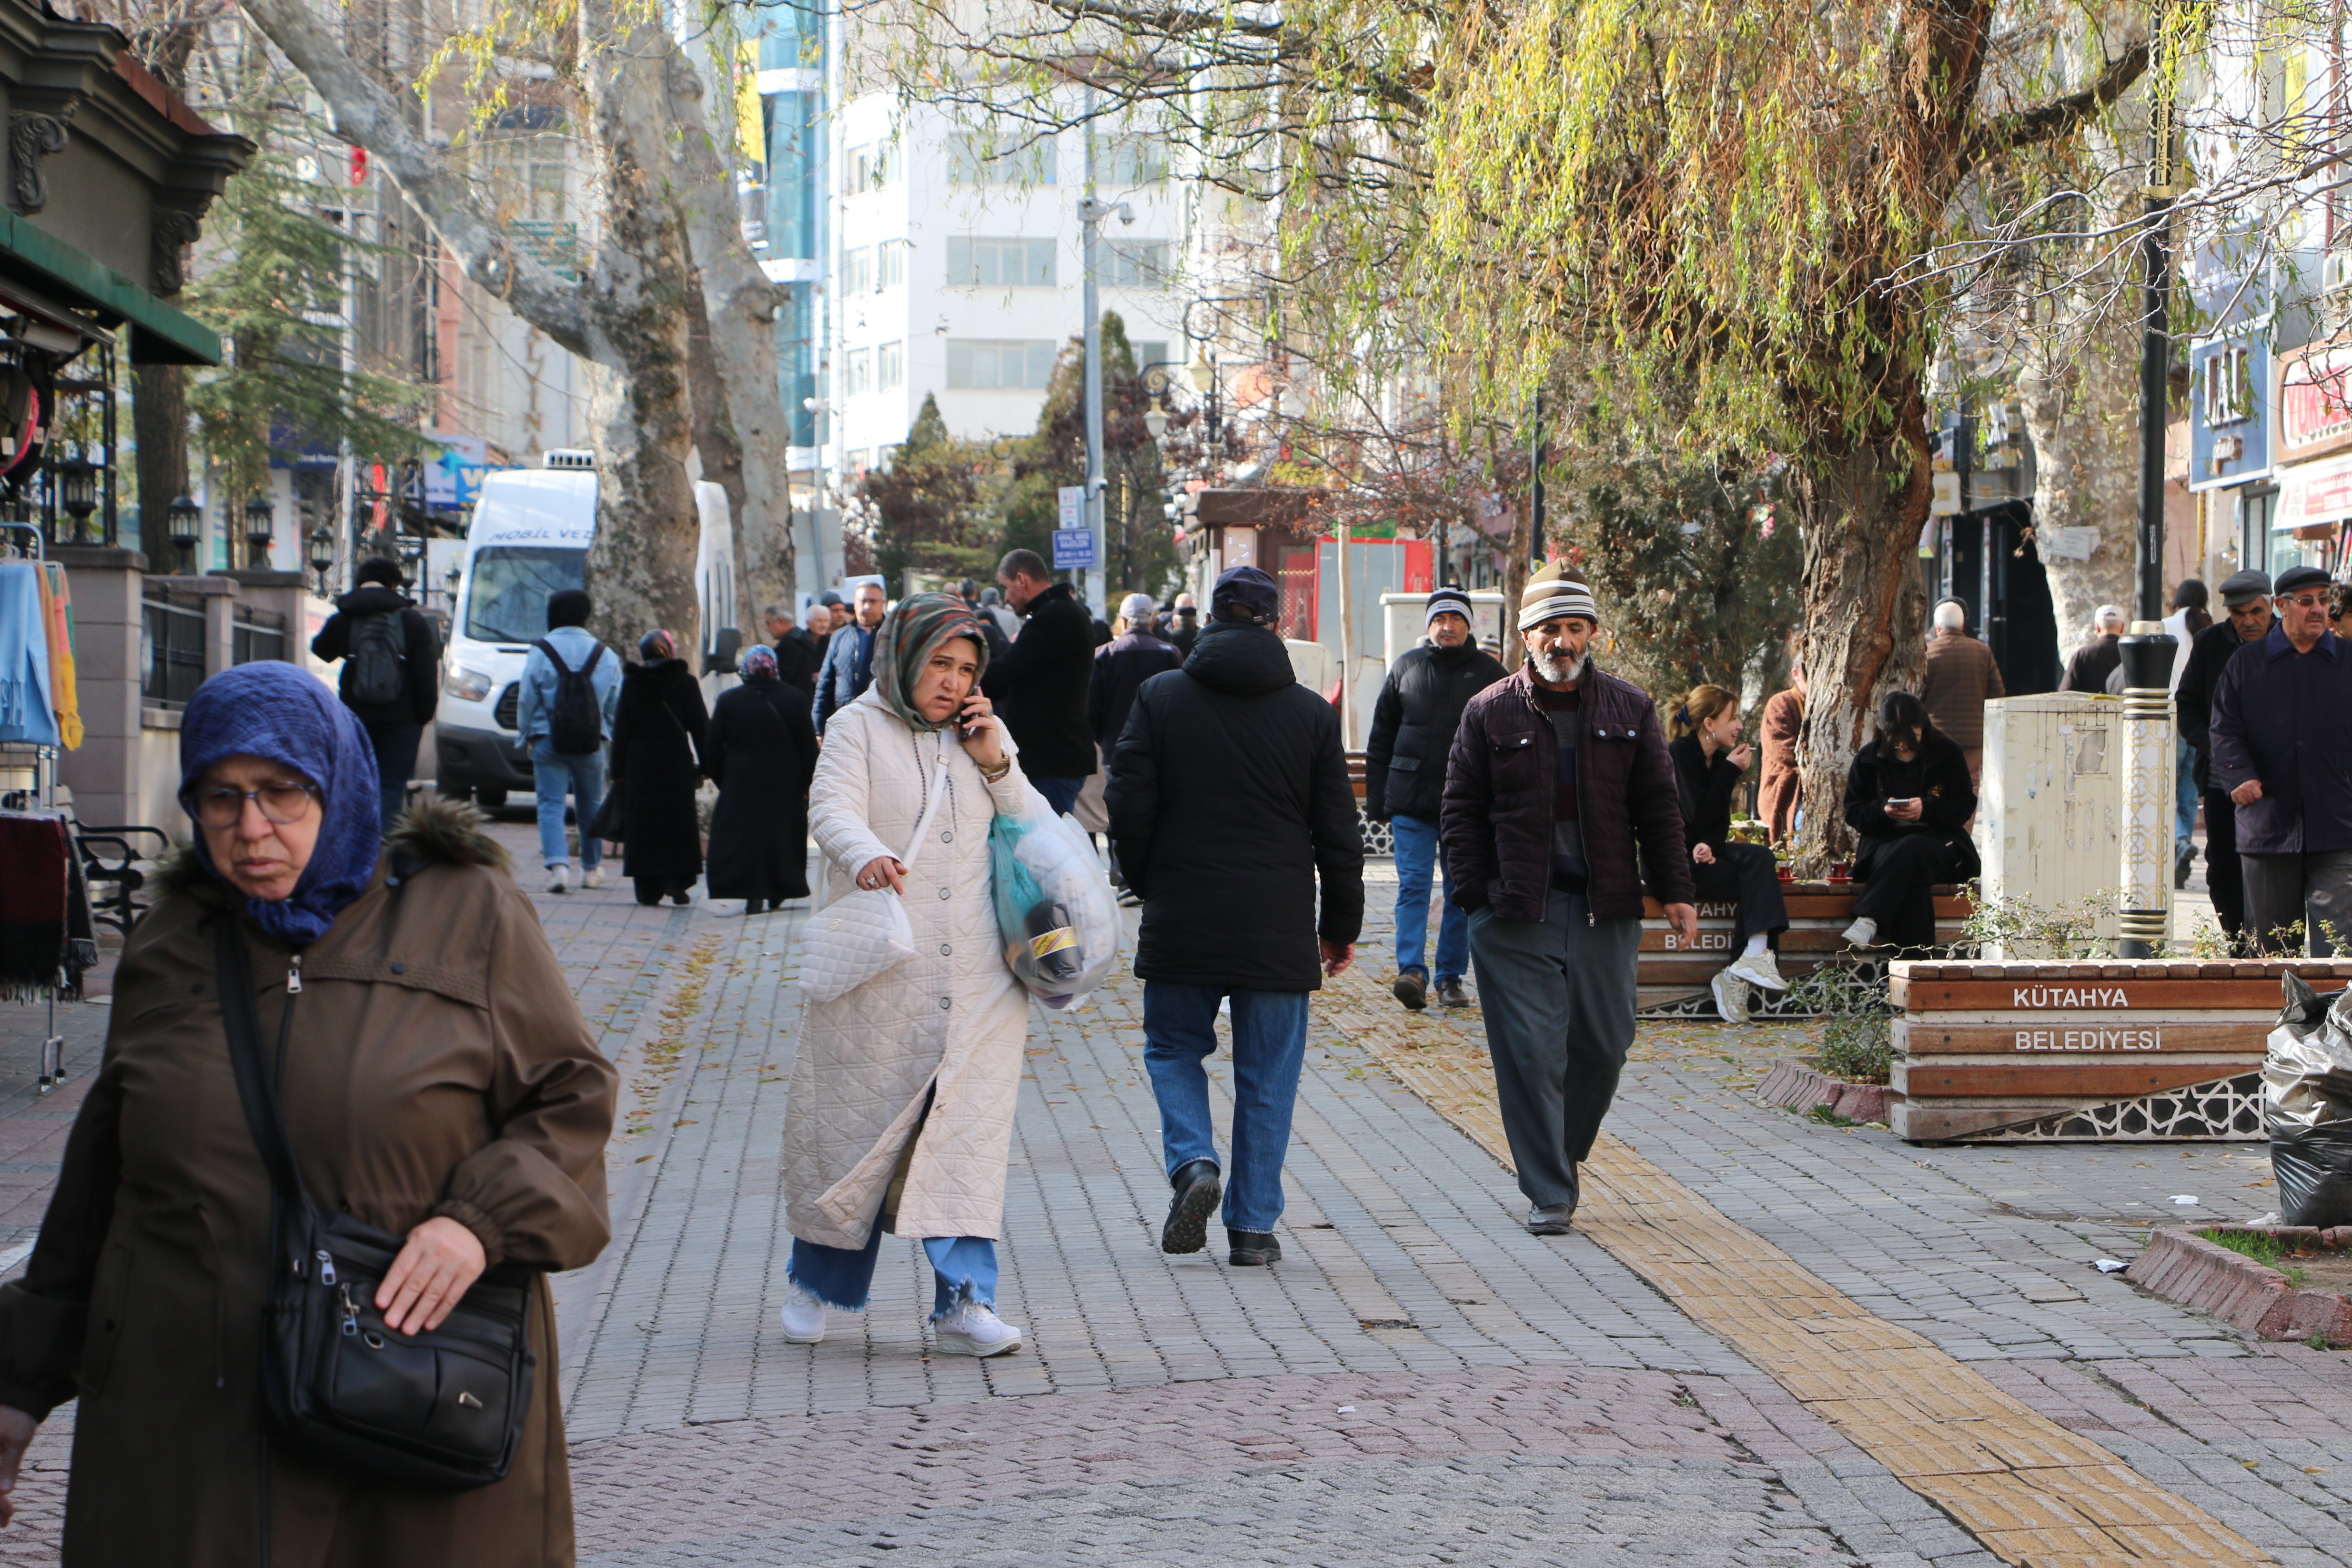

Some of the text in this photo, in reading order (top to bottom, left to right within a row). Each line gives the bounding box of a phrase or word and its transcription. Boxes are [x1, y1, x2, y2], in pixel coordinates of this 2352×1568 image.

[488, 527, 595, 541] MOBİL VEZ
[1663, 902, 1738, 917] TAHY
[2013, 984, 2129, 1007] KÜTAHYA
[2015, 1026, 2161, 1050] BELEDİYESİ
